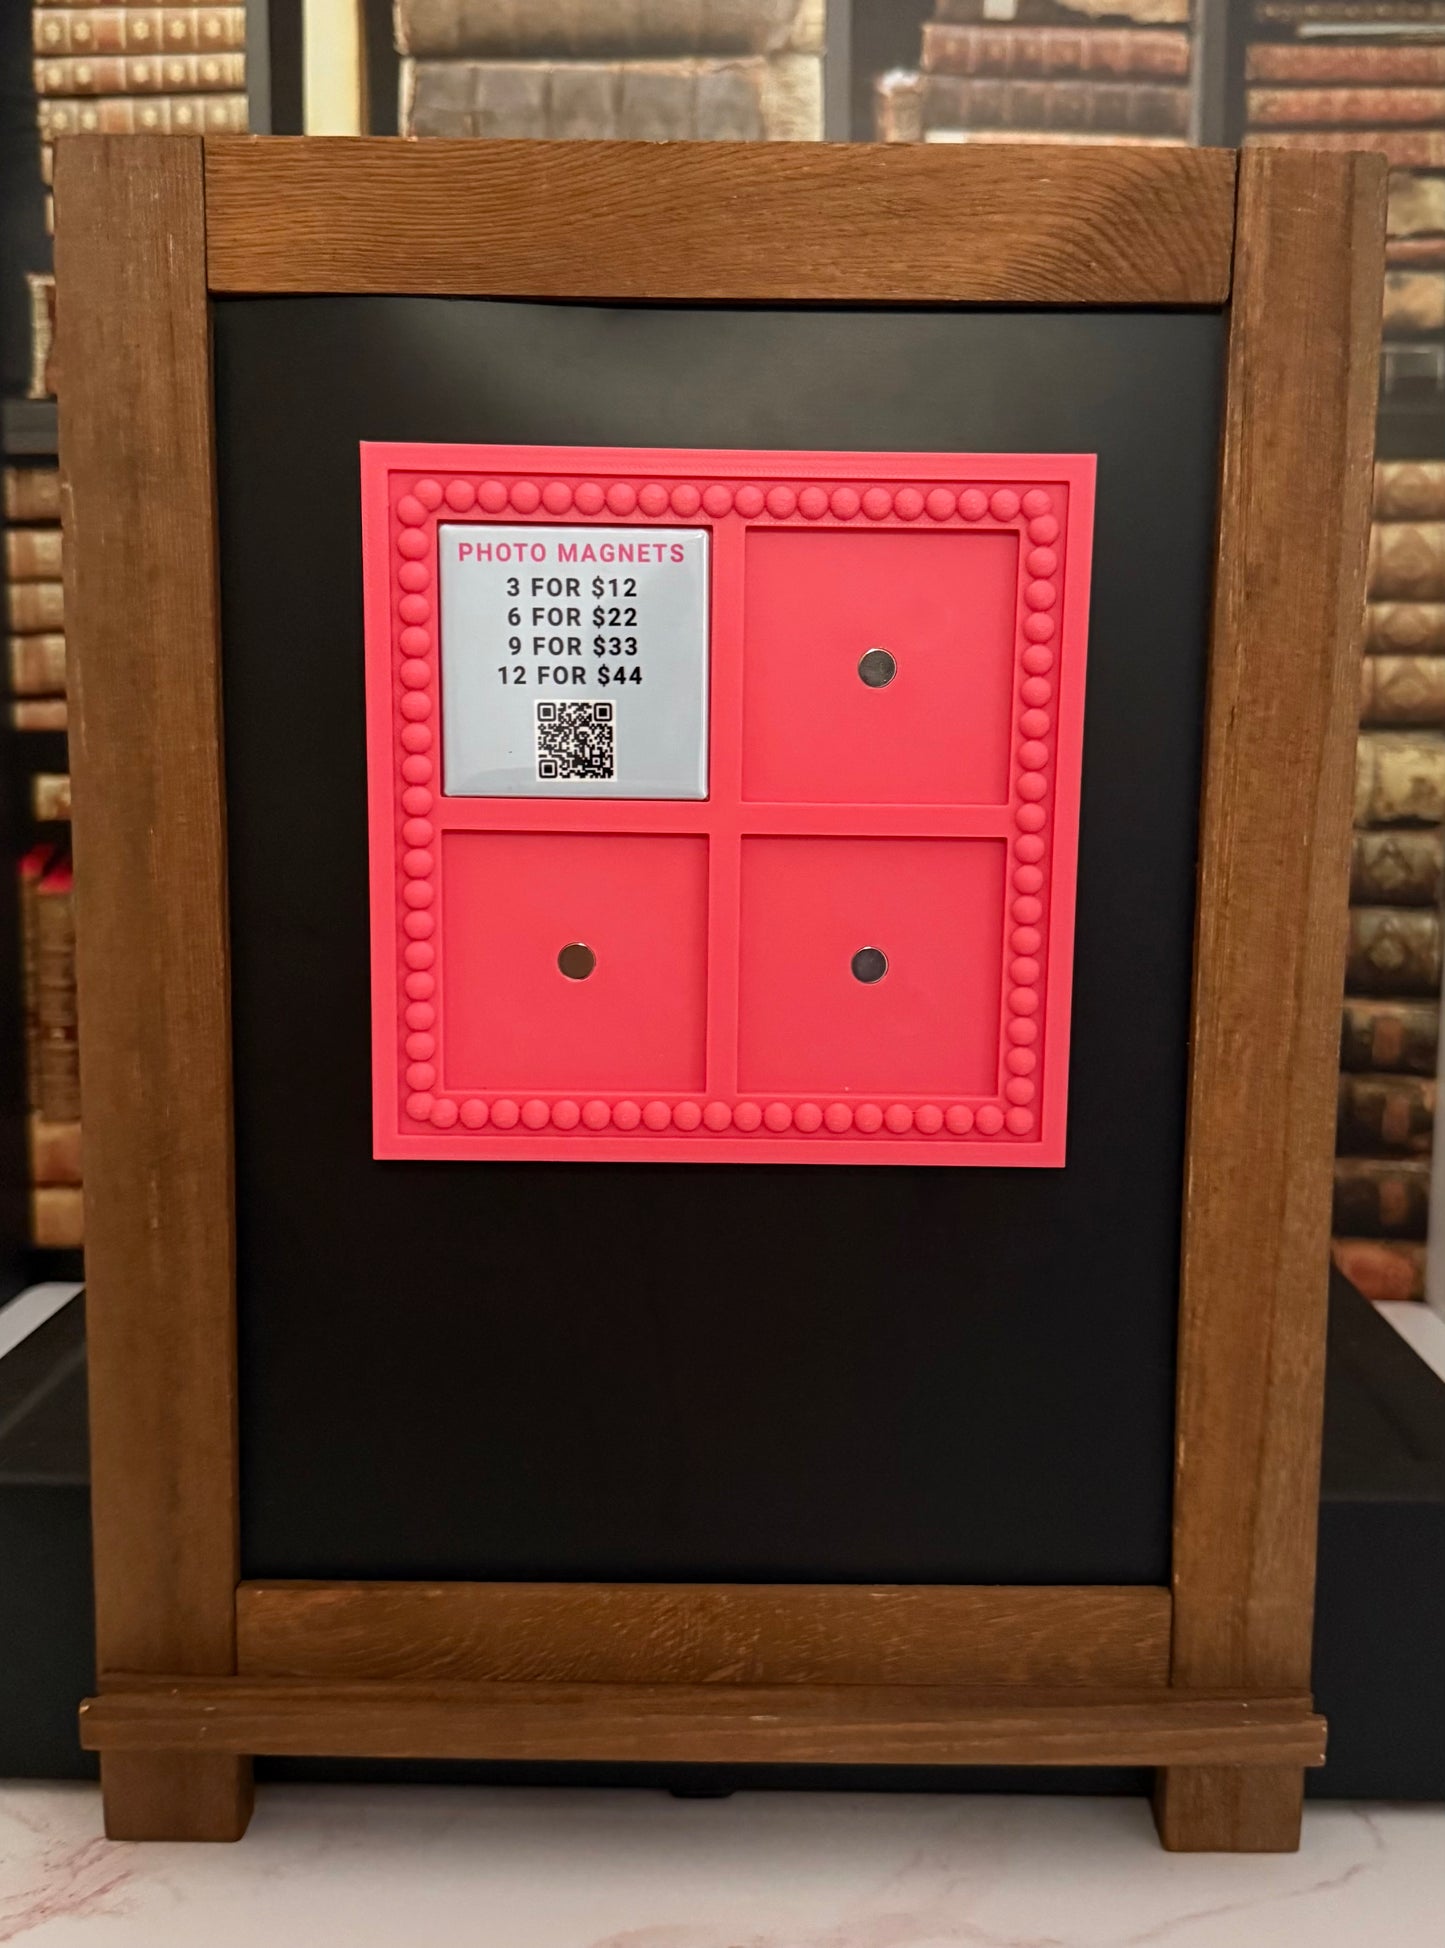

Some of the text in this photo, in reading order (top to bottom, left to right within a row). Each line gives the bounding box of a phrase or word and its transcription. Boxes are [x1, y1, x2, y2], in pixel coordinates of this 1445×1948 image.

[458, 542, 685, 563] PHOTO MAGNETS
[506, 575, 638, 600] 3 FOR $12
[507, 605, 638, 629] 6 FOR $22
[508, 634, 638, 659] 9 FOR $33
[497, 663, 643, 688] 12 FOR $44
